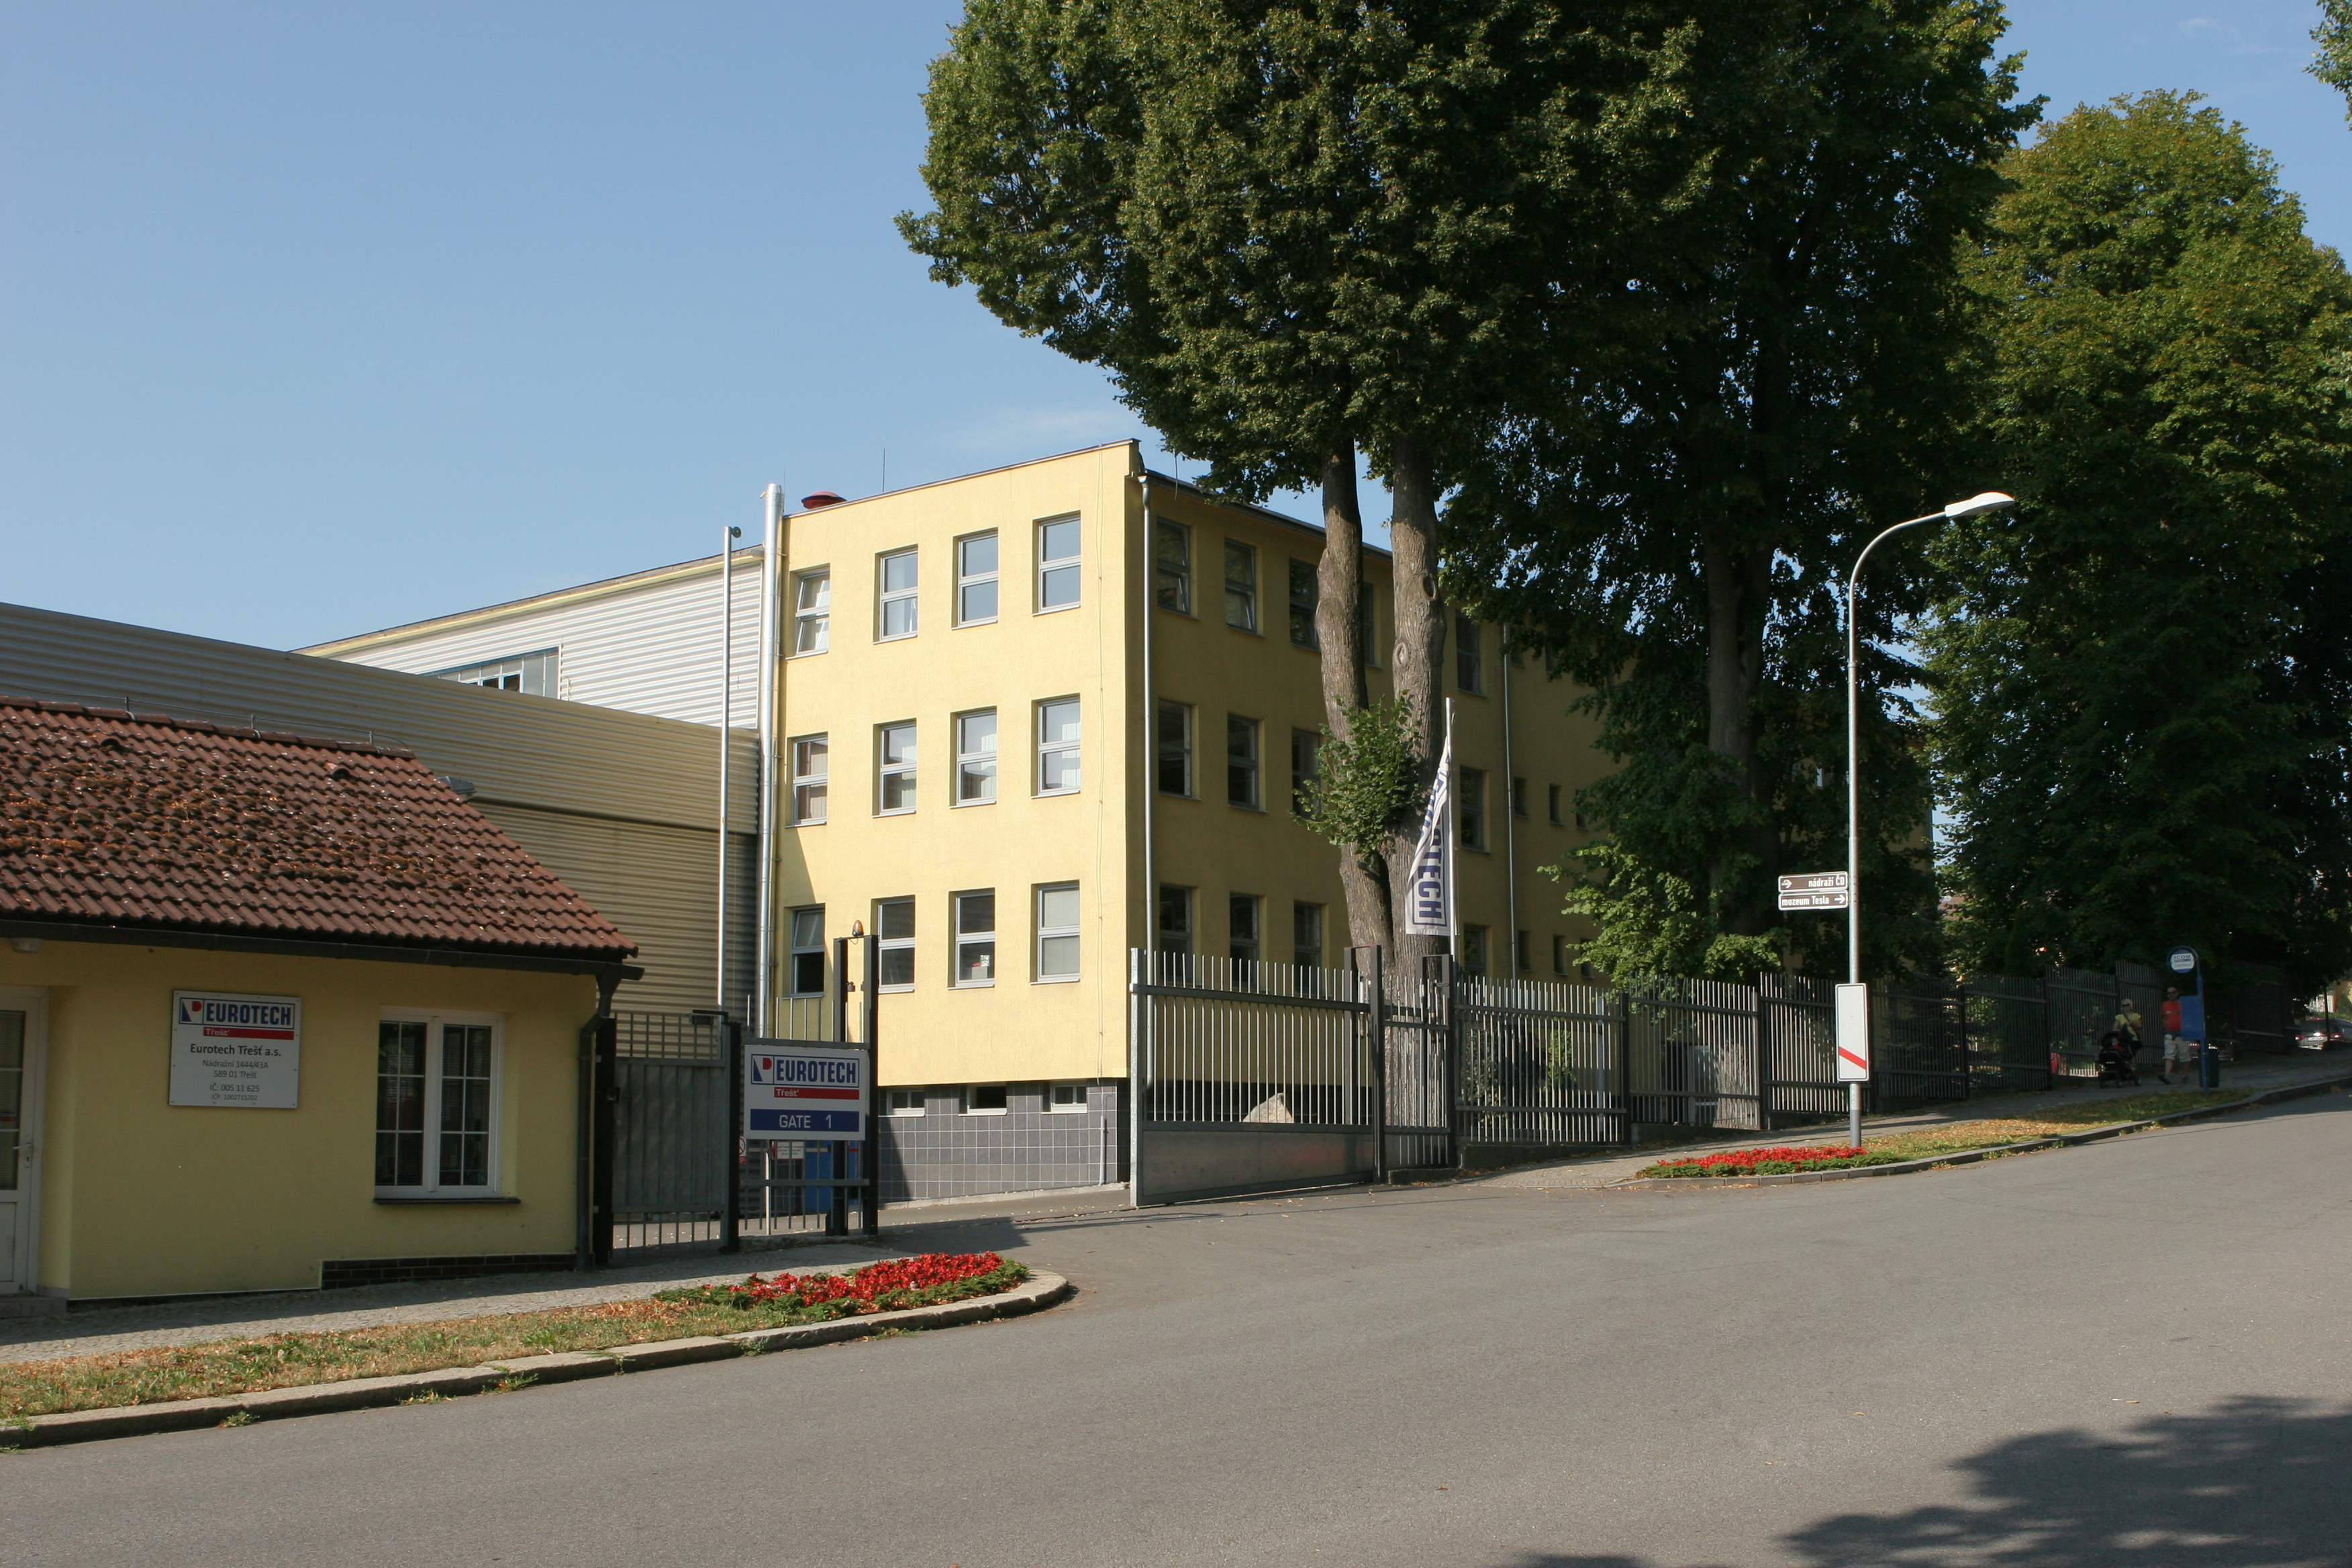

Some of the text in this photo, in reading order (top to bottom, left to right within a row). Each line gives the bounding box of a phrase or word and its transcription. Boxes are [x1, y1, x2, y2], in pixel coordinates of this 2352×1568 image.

[1808, 875, 1845, 887] nádraží ČD
[1781, 895, 1830, 906] muzeum Tesla
[206, 1003, 291, 1026] EUROTECH
[190, 1044, 282, 1057] Eurotech Třešť a.s.
[203, 1060, 234, 1068] Nádražní
[240, 1071, 257, 1079] Třešť
[776, 1059, 856, 1083] EUROTECH
[209, 1083, 219, 1091] IČ:
[776, 1089, 799, 1097] Třešť
[779, 1114, 832, 1128] GATE 1
